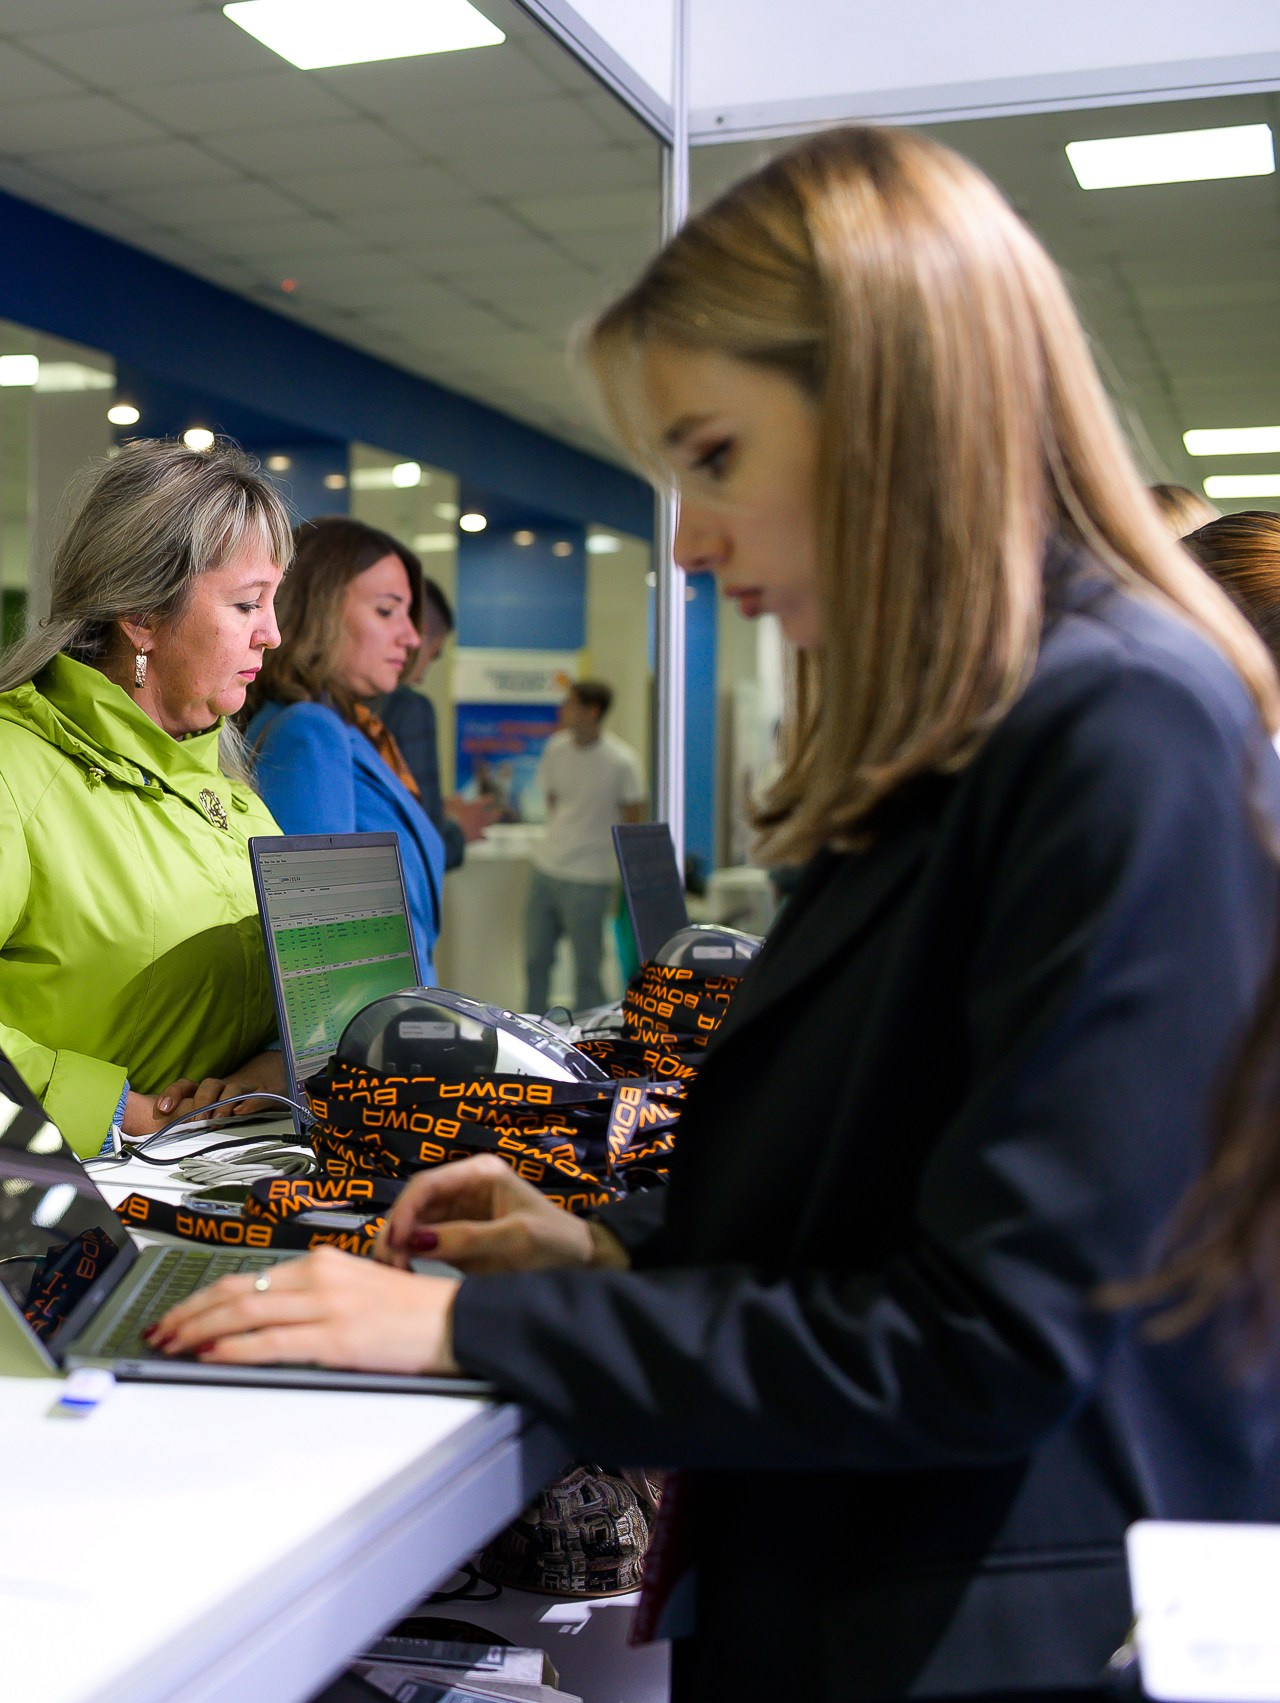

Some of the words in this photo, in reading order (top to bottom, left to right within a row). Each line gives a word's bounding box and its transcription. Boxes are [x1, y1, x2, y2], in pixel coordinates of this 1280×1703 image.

[643, 1050, 699, 1082] BOW
[439, 1081, 553, 1105] BOWA
[363, 1107, 461, 1139] BOWA
[269, 1179, 374, 1200] BOWA
[176, 1213, 274, 1248] BOWA
